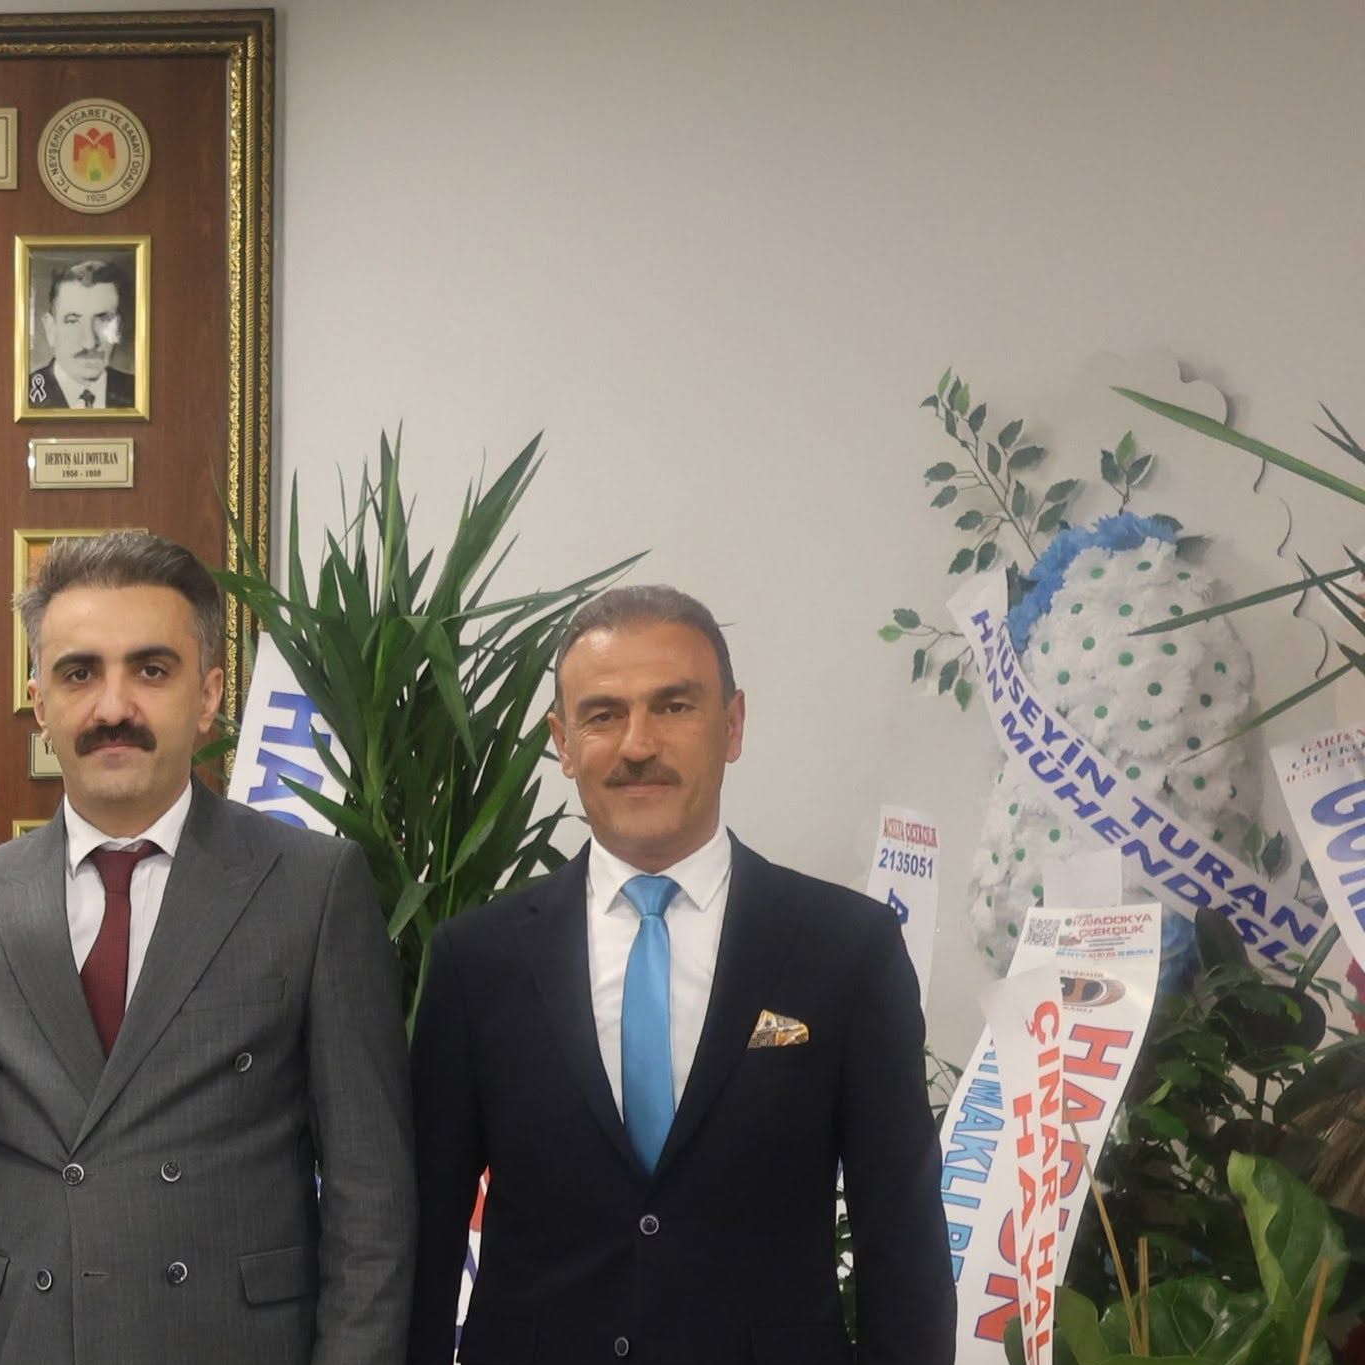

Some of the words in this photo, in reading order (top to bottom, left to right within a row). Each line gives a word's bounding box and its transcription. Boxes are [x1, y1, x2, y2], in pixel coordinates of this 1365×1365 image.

[973, 609, 1004, 704] HAN
[878, 847, 934, 880] 2135051
[1131, 795, 1319, 946] TURAN
[1025, 1000, 1060, 1215] ÇINAR
